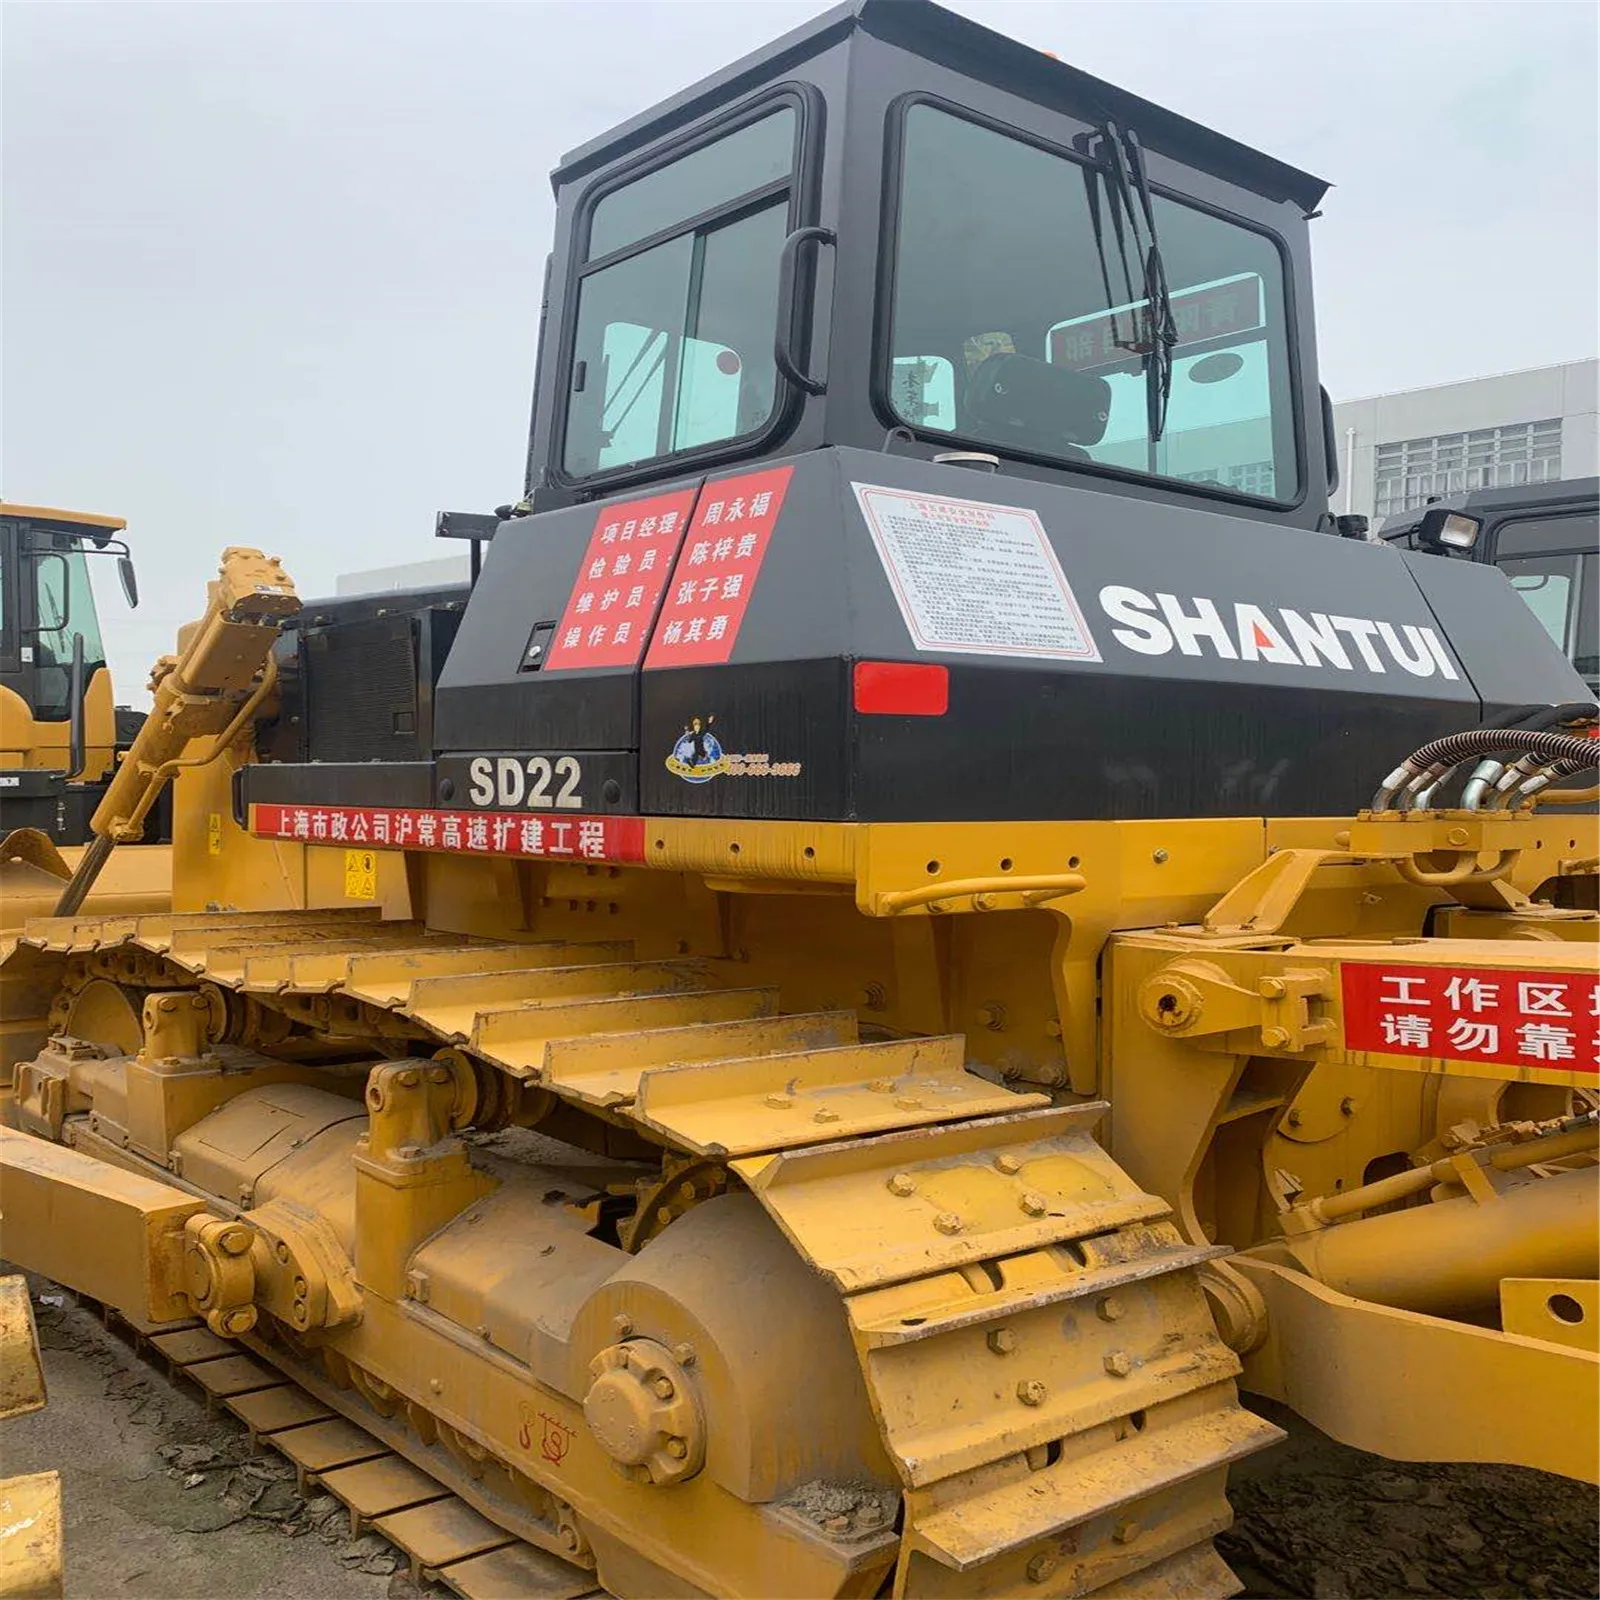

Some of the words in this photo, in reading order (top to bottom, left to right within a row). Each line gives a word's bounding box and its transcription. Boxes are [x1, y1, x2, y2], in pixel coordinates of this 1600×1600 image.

[702, 491, 773, 527] 周永福
[688, 533, 757, 566] 陈梓贵
[676, 574, 744, 605] 张子强
[662, 615, 729, 646] 杨其勇
[1099, 585, 1460, 681] SHANTUI
[469, 757, 583, 809] SD22
[276, 808, 606, 859] 上海市政公司沪常高速扩建工程
[1380, 975, 1600, 1018] 工作区
[1380, 1013, 1600, 1064] 请勿靠
